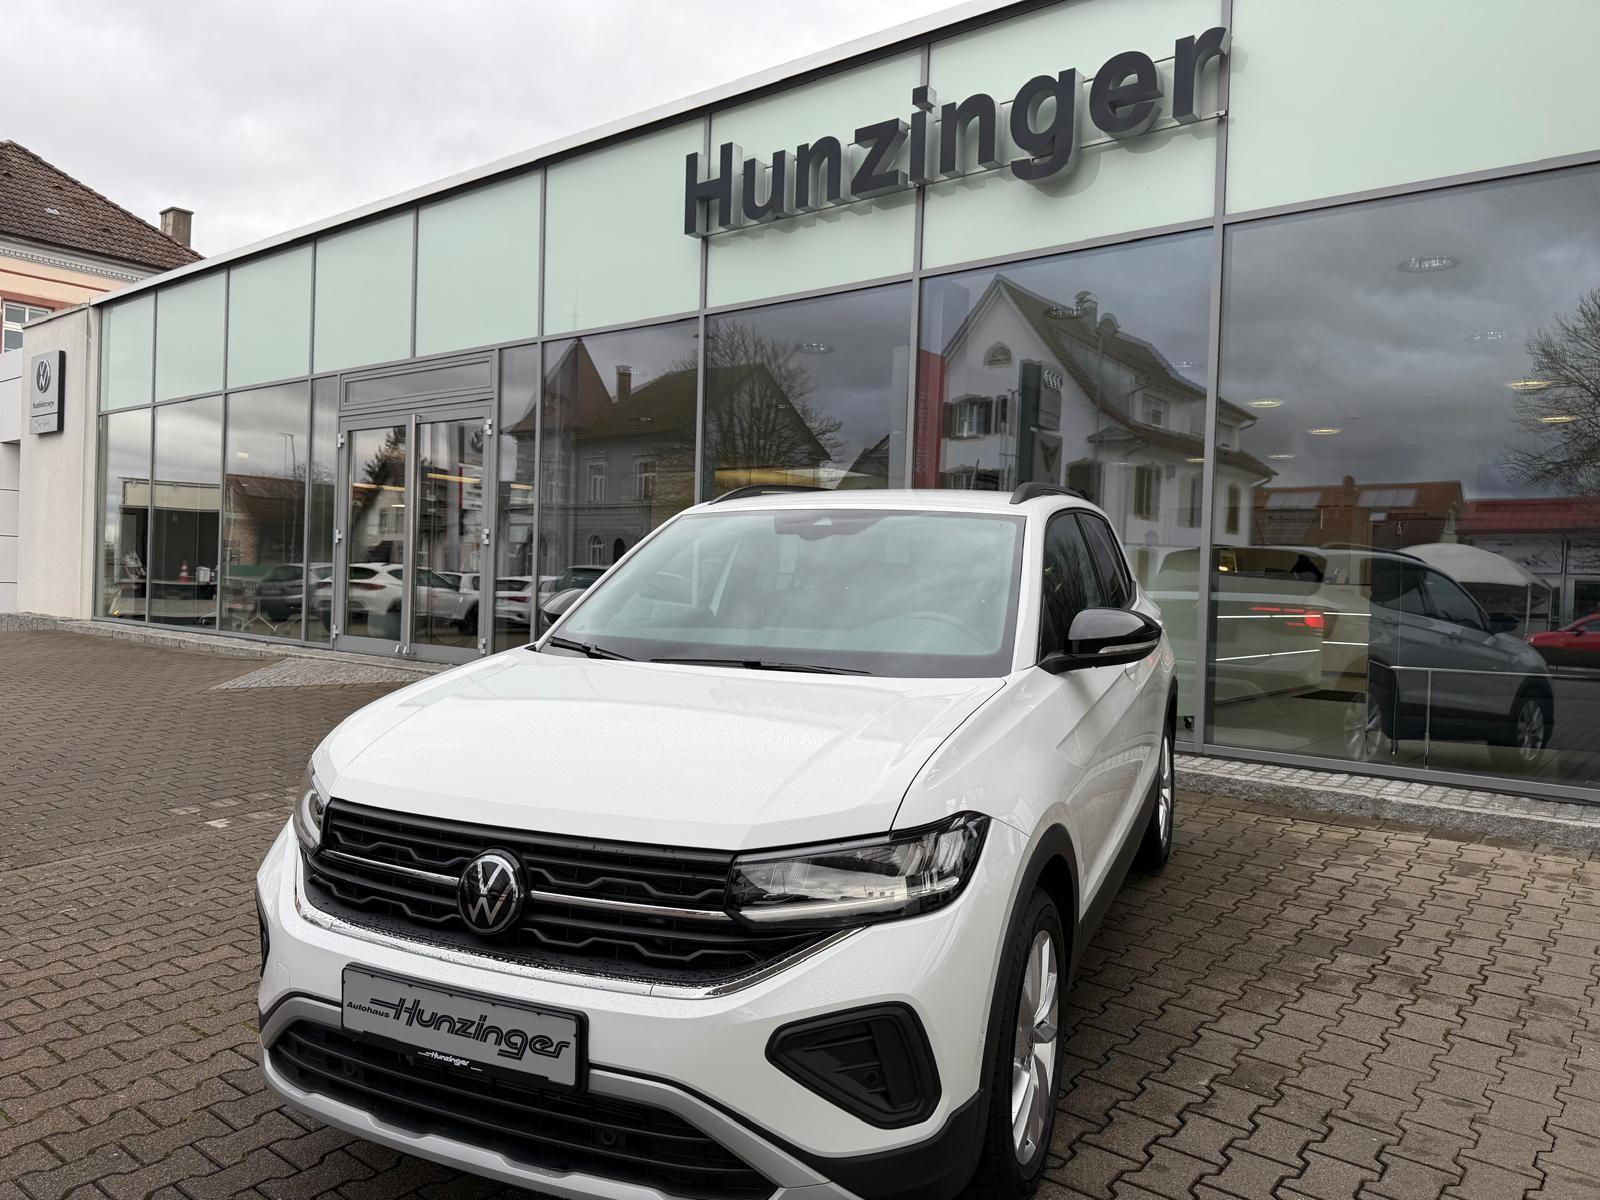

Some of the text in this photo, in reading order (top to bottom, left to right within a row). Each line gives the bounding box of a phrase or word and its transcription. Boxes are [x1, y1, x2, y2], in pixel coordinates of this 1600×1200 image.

[685, 27, 1231, 237] Hunzinger
[346, 997, 570, 1060] Autohaus Hunzinger
[420, 1051, 470, 1067] Hunzinger
